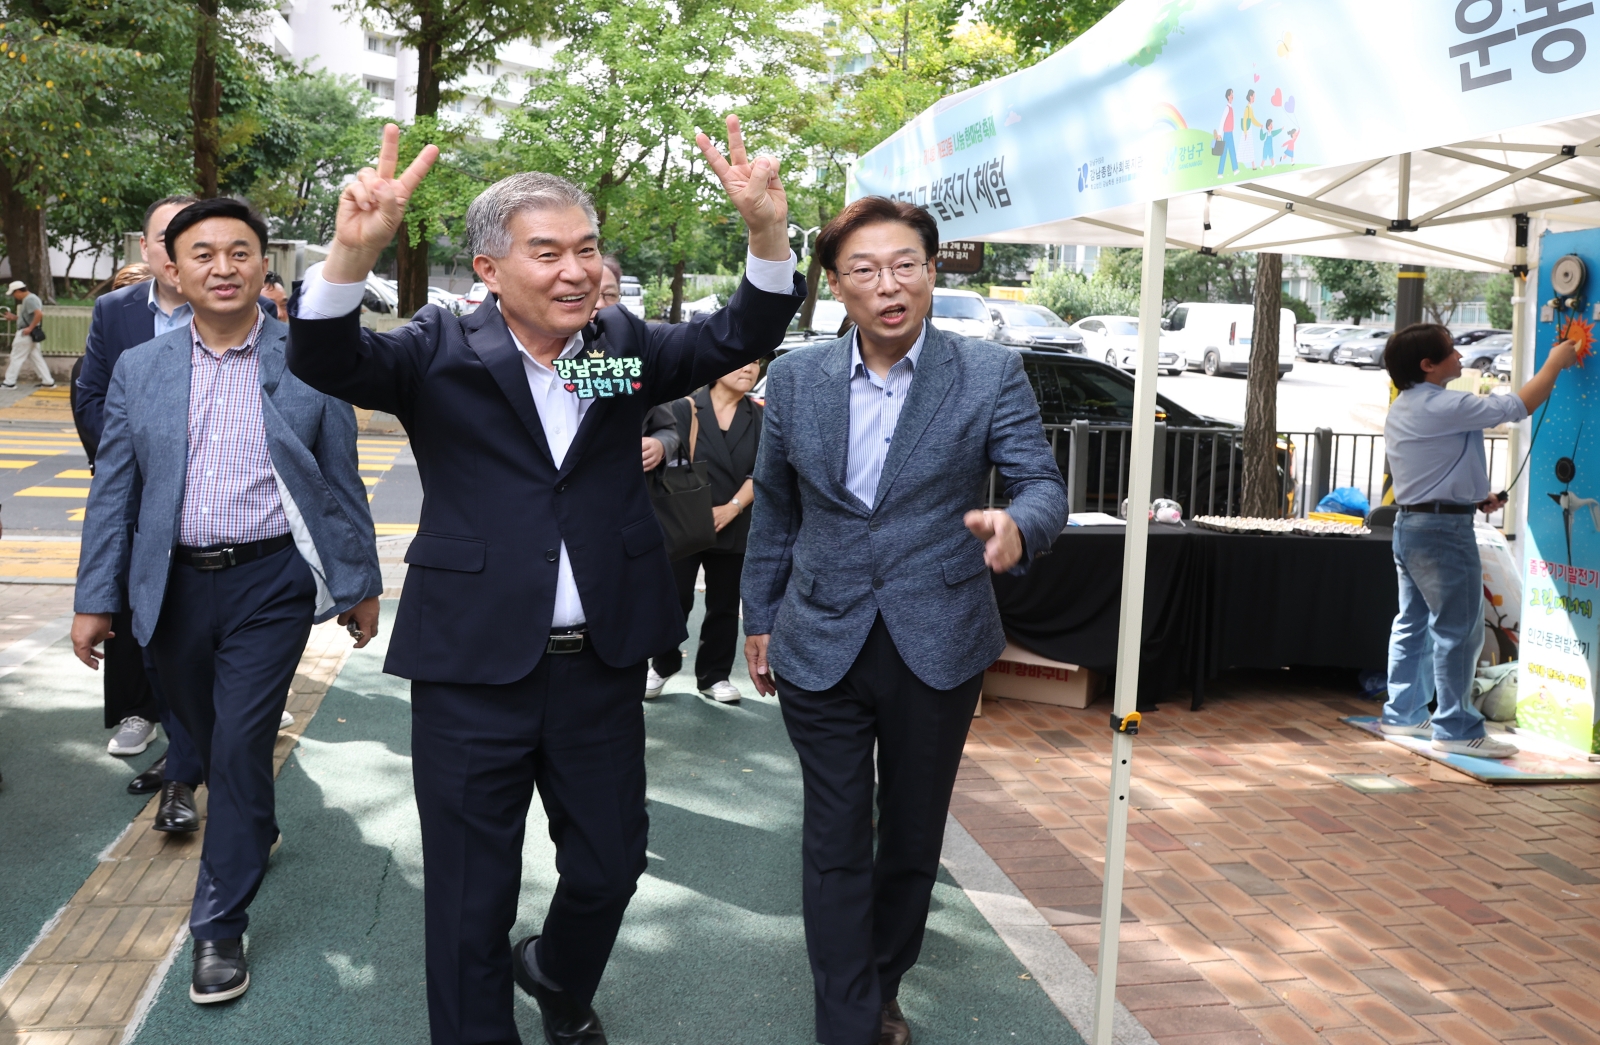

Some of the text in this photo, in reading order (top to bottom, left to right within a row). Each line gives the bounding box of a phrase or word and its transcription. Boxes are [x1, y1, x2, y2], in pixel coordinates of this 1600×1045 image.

[1448, 0, 1595, 93] 운동
[1179, 142, 1204, 162] 강남구
[931, 167, 979, 221] 발전기
[973, 155, 1012, 208] 체험
[956, 251, 969, 260] 금지
[962, 243, 975, 251] 부과
[552, 357, 643, 379] 강남구청장
[572, 377, 633, 398] 김현기
[1530, 559, 1599, 589] 줄당기기발전기
[1530, 588, 1593, 618] 그린에너지
[1528, 627, 1590, 660] 인간동력발전기
[1014, 663, 1069, 682] 장바구니
